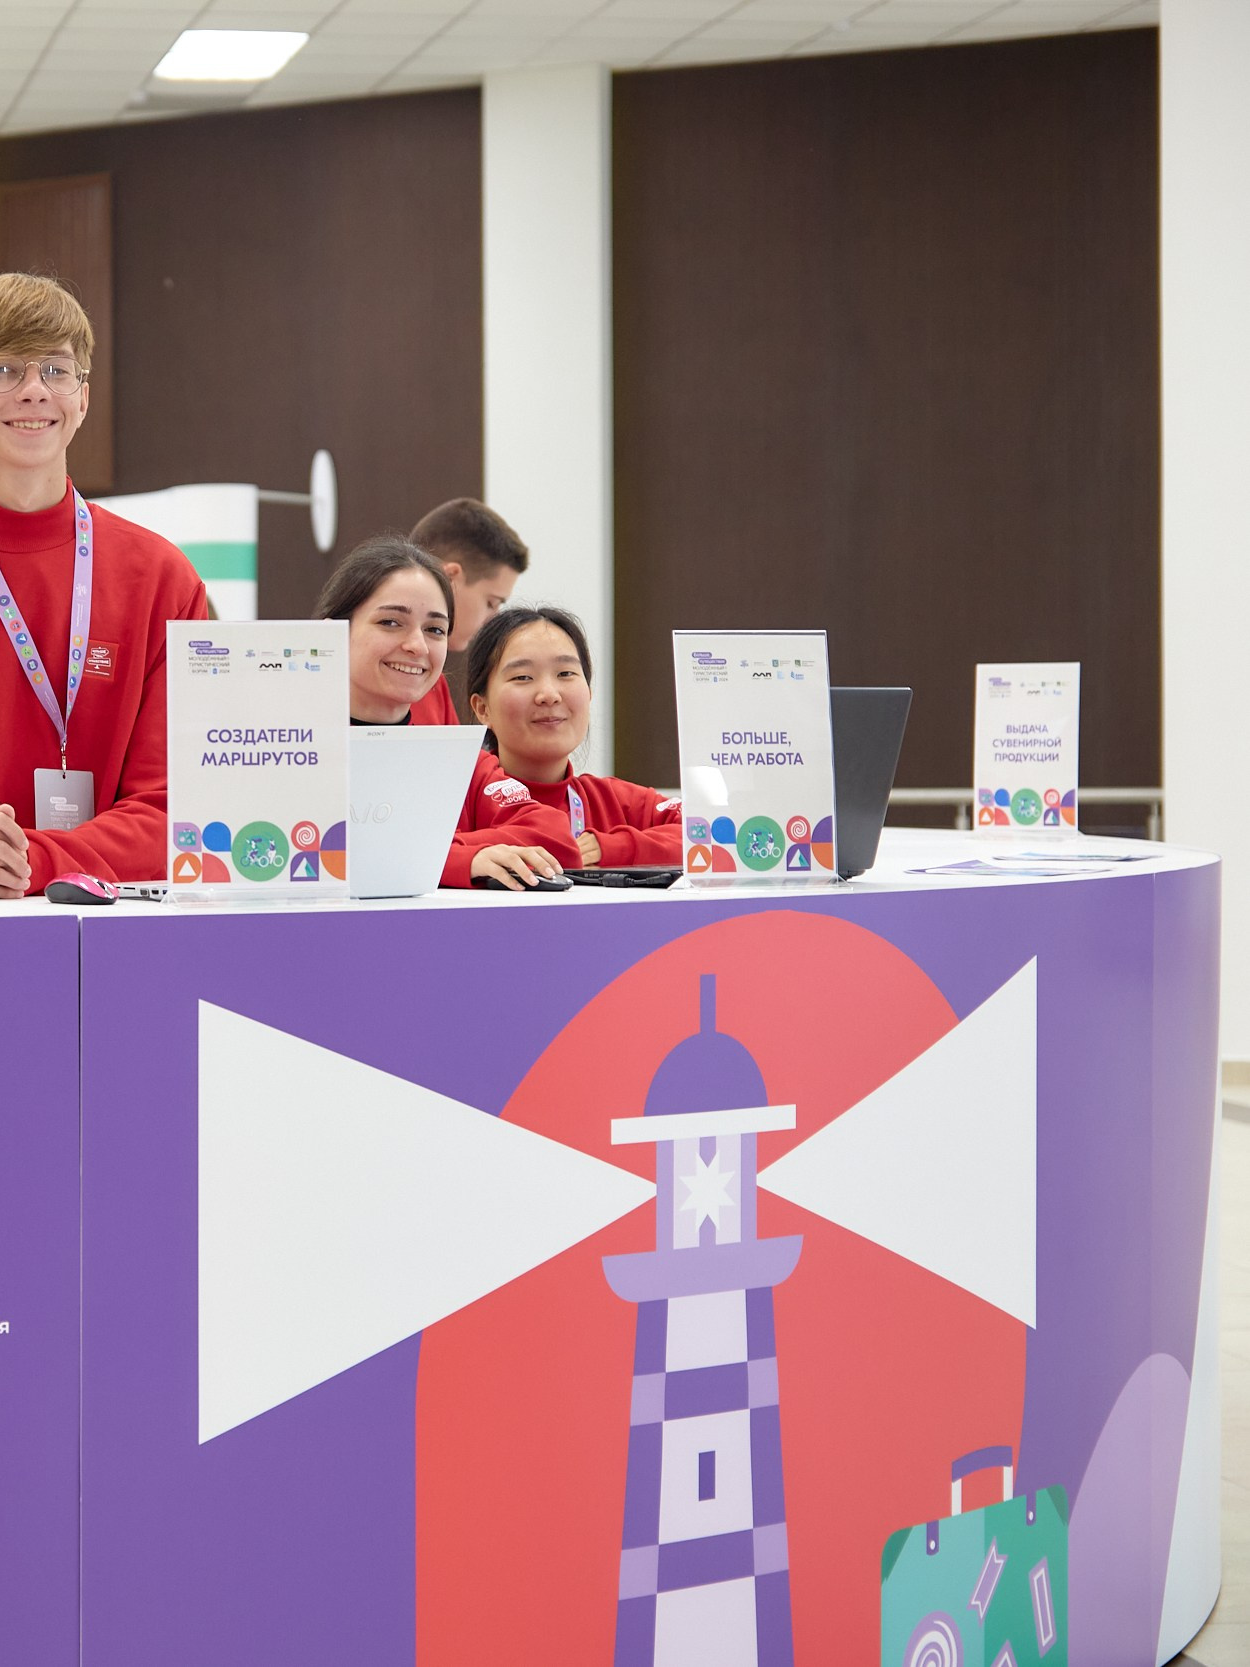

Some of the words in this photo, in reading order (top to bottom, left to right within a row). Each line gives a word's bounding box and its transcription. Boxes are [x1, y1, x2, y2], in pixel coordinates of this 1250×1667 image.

[206, 728, 313, 745] СОЗДАТЕЛИ
[1006, 724, 1049, 735] ВЫДАЧА
[722, 731, 792, 748] БОЛЬШЕ,
[992, 737, 1062, 748] СУВЕНИРНОЙ
[201, 751, 319, 766] МАРШРУТОВ
[711, 752, 742, 766] ЧЕМ
[747, 752, 804, 766] РАБОТА
[994, 753, 1060, 763] ПРОДУКЦИИ
